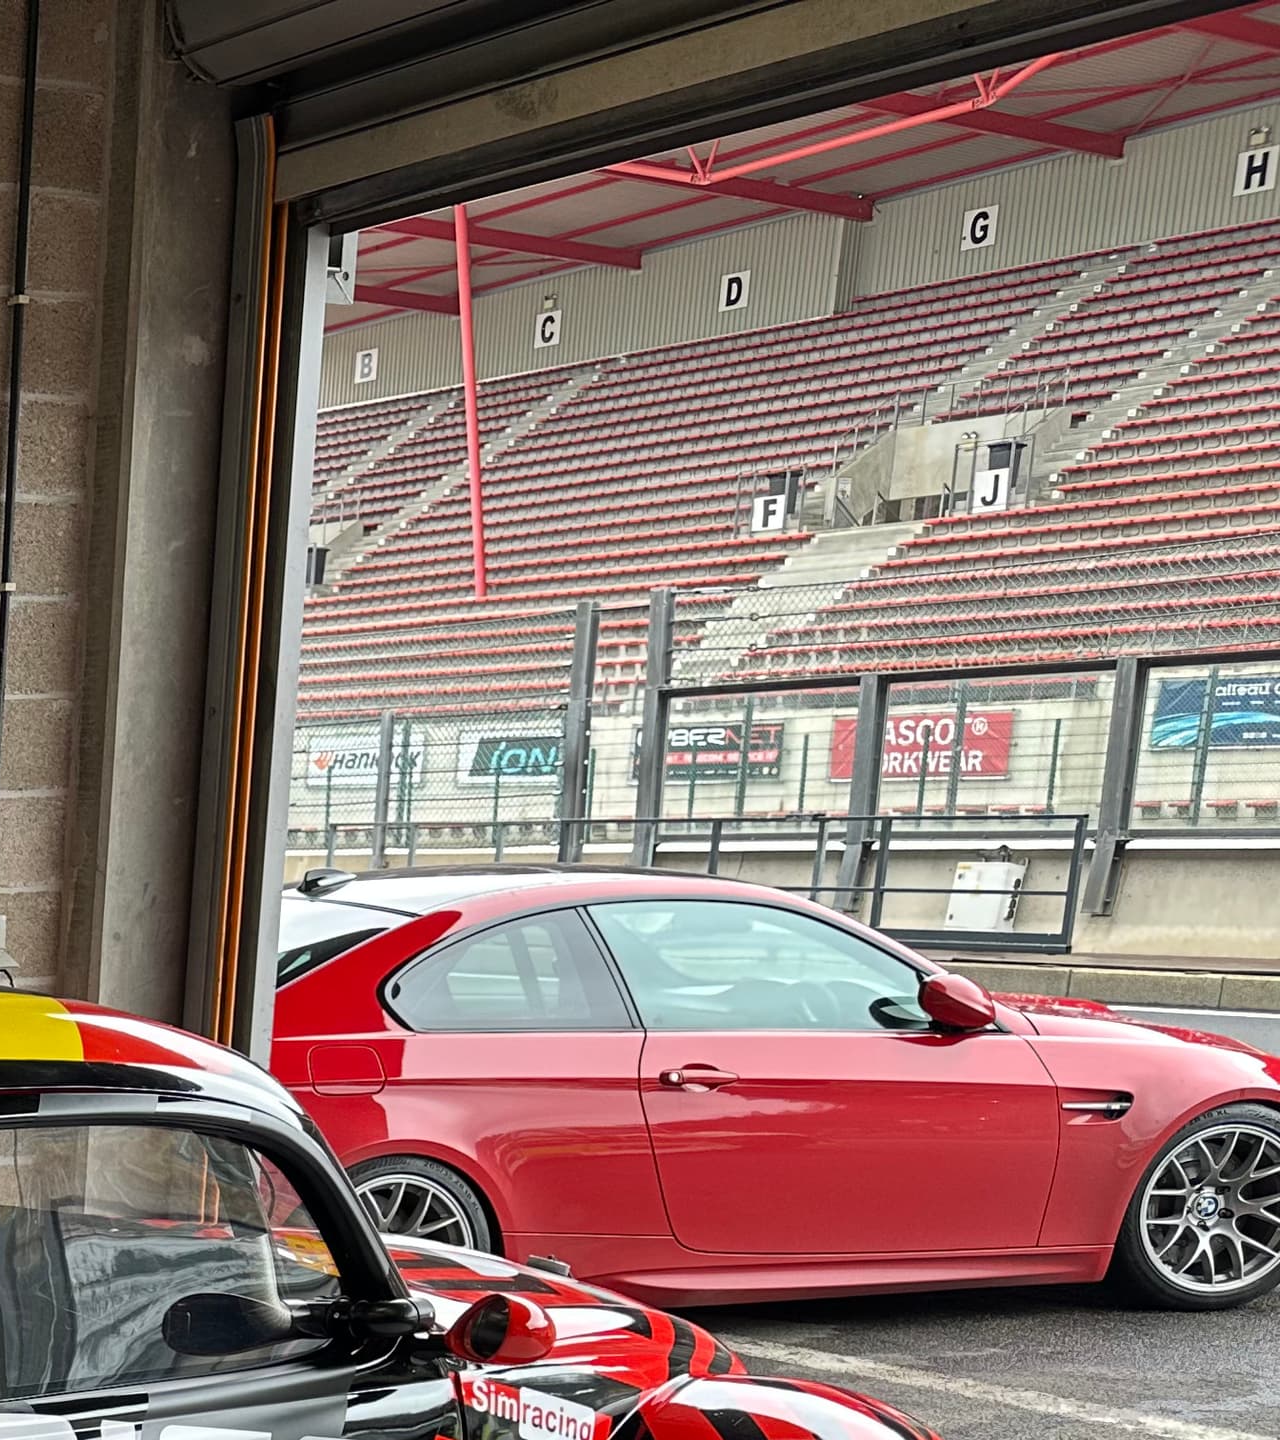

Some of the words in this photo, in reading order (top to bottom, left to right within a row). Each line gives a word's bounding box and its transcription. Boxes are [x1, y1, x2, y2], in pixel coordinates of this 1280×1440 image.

[1243, 150, 1270, 191] H
[970, 210, 990, 245] G
[724, 275, 743, 307] D
[540, 314, 556, 345] C
[359, 351, 374, 379] B
[980, 473, 1000, 506] J
[761, 499, 781, 529] F
